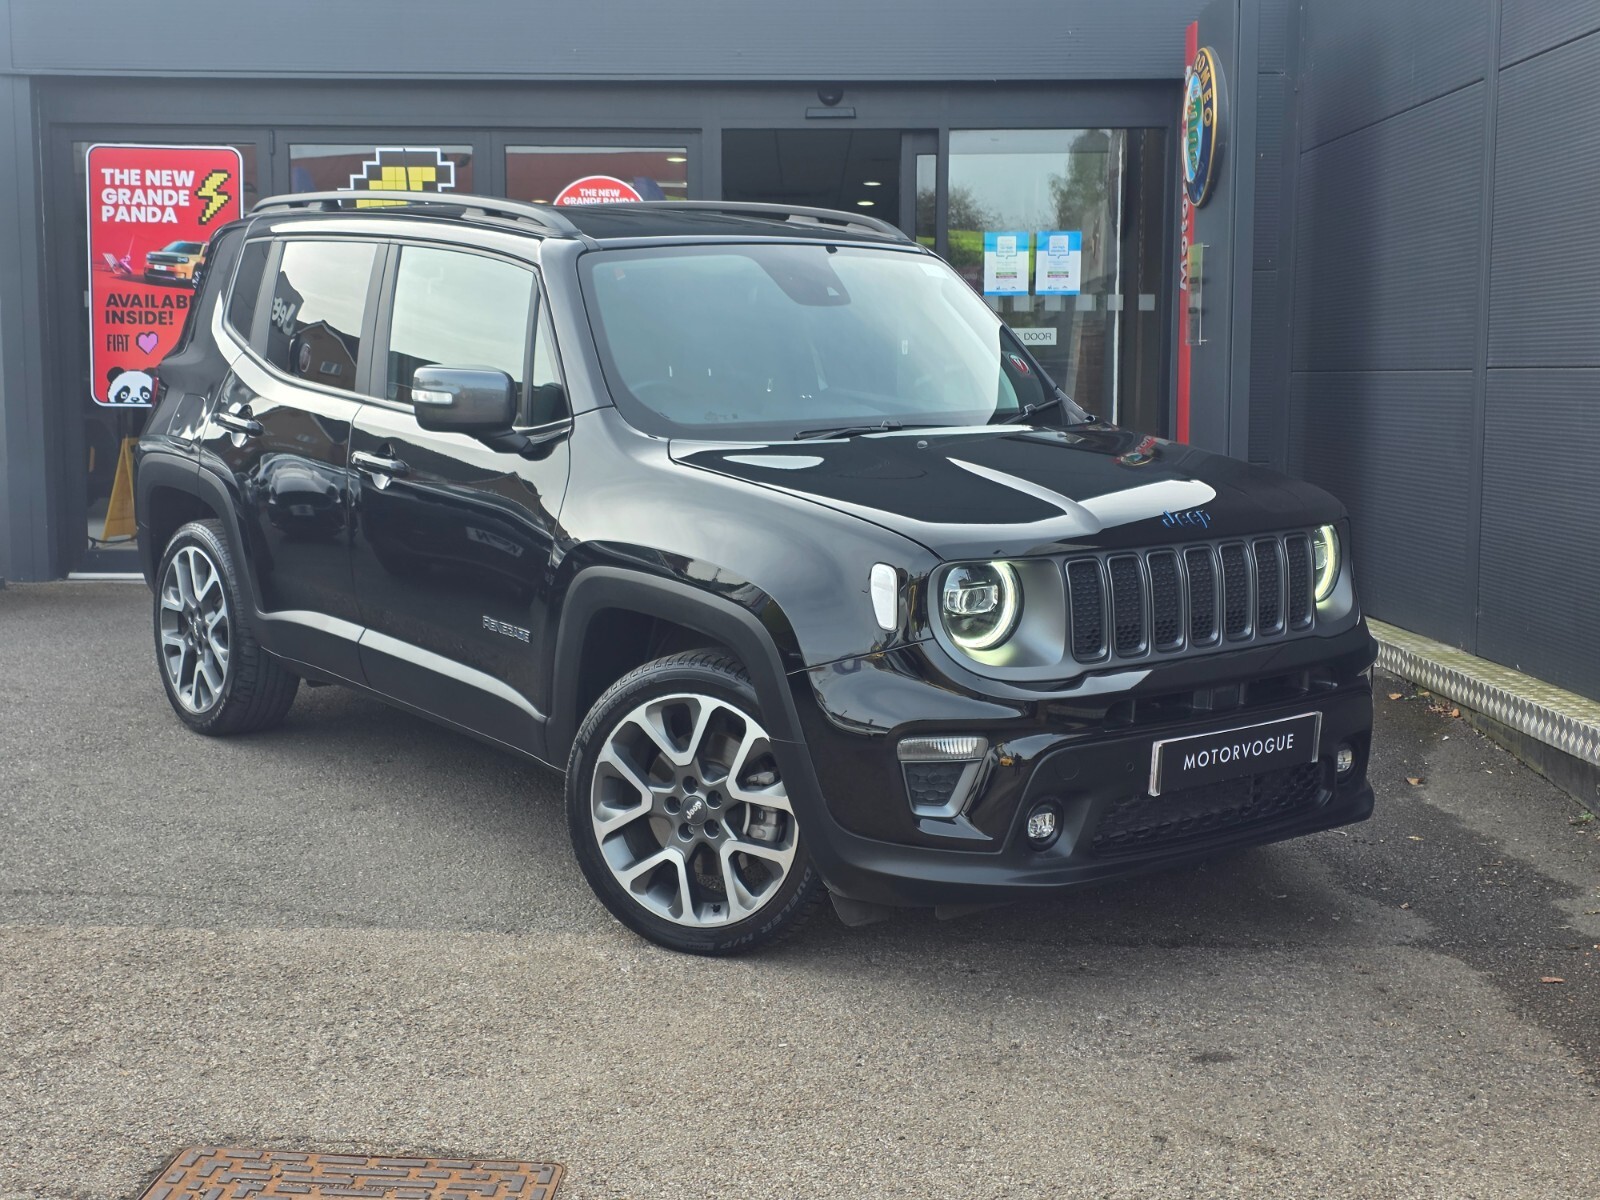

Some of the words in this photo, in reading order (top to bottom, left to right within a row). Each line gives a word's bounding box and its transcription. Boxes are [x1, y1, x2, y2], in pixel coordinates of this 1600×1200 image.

[101, 168, 141, 186] THE
[145, 169, 195, 187] NEW
[101, 188, 190, 207] GRANDE
[563, 196, 602, 205] GRANDE
[579, 188, 597, 197] THE
[598, 189, 620, 197] NEW
[101, 205, 178, 224] PANDA
[105, 293, 192, 309] AVAILAB
[105, 310, 174, 326] INSIDE!
[106, 334, 130, 352] FIAT
[1023, 332, 1052, 341] DOOR
[1183, 733, 1295, 771] MOTORVOGUE
[686, 800, 702, 819] Jeep
